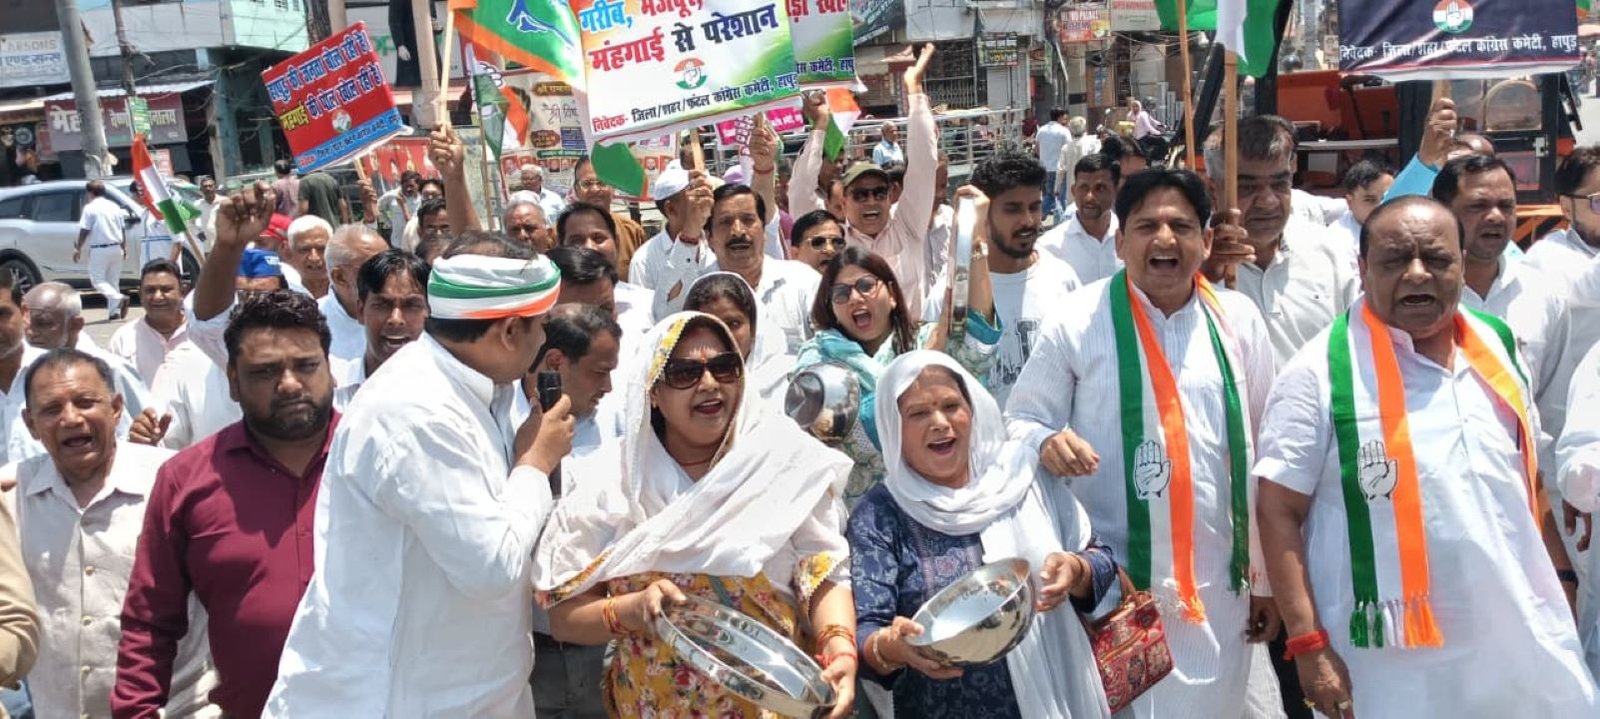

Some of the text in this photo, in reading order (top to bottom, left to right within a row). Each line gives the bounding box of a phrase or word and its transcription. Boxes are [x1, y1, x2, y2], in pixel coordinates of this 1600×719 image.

[588, 26, 665, 71] मंहगाई
[671, 22, 696, 52] से
[700, 3, 779, 43] परेशान
[712, 86, 742, 102] कांग्रेस
